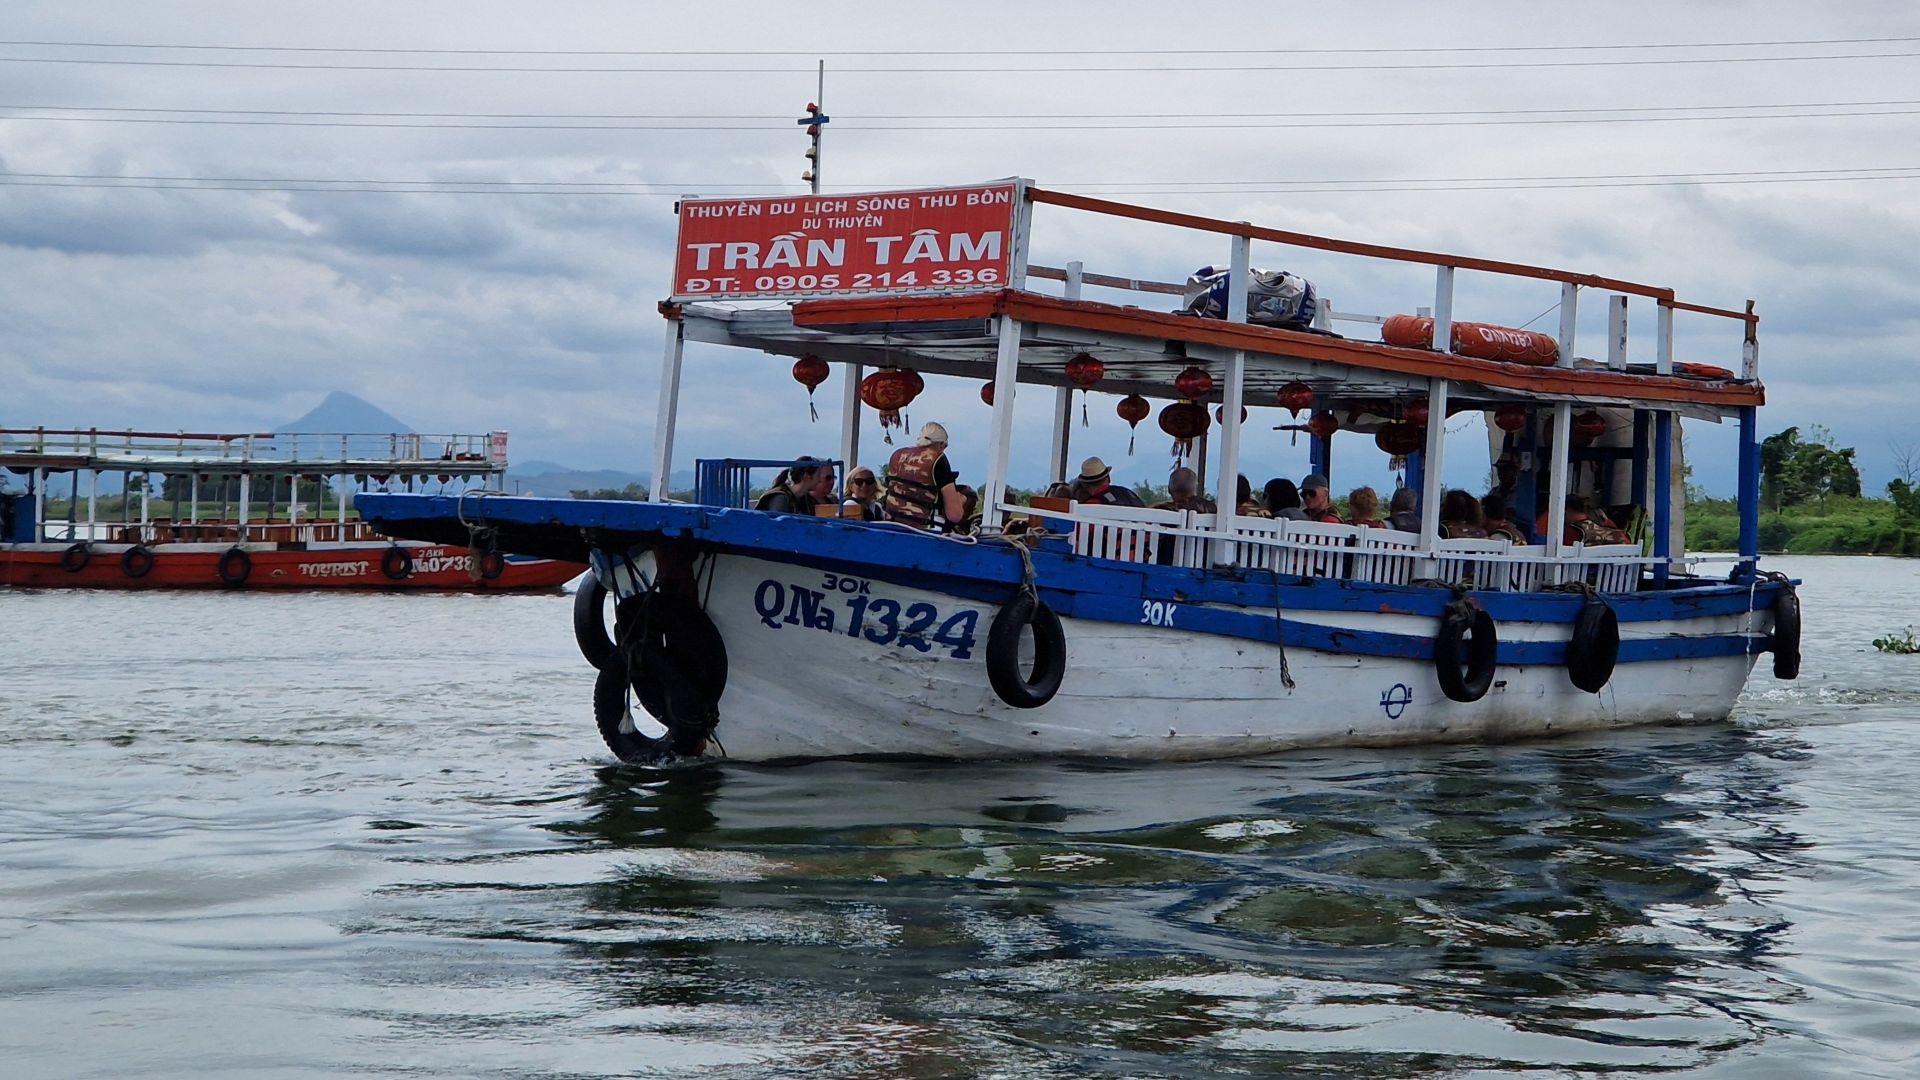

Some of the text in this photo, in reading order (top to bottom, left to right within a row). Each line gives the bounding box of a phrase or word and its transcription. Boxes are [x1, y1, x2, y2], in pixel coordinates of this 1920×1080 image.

[770, 202, 796, 216] DU
[804, 201, 848, 216] LỊCH
[856, 196, 910, 212] SÔNG
[918, 194, 958, 208] THU
[802, 218, 821, 229] DU
[687, 229, 1002, 271] TRẦN TÂM
[684, 268, 998, 292] ĐT: 0905 214 336
[298, 560, 369, 578] TOURIST
[821, 573, 871, 595] 30K
[1141, 600, 1177, 627] 30K
[846, 595, 979, 660] 1324
